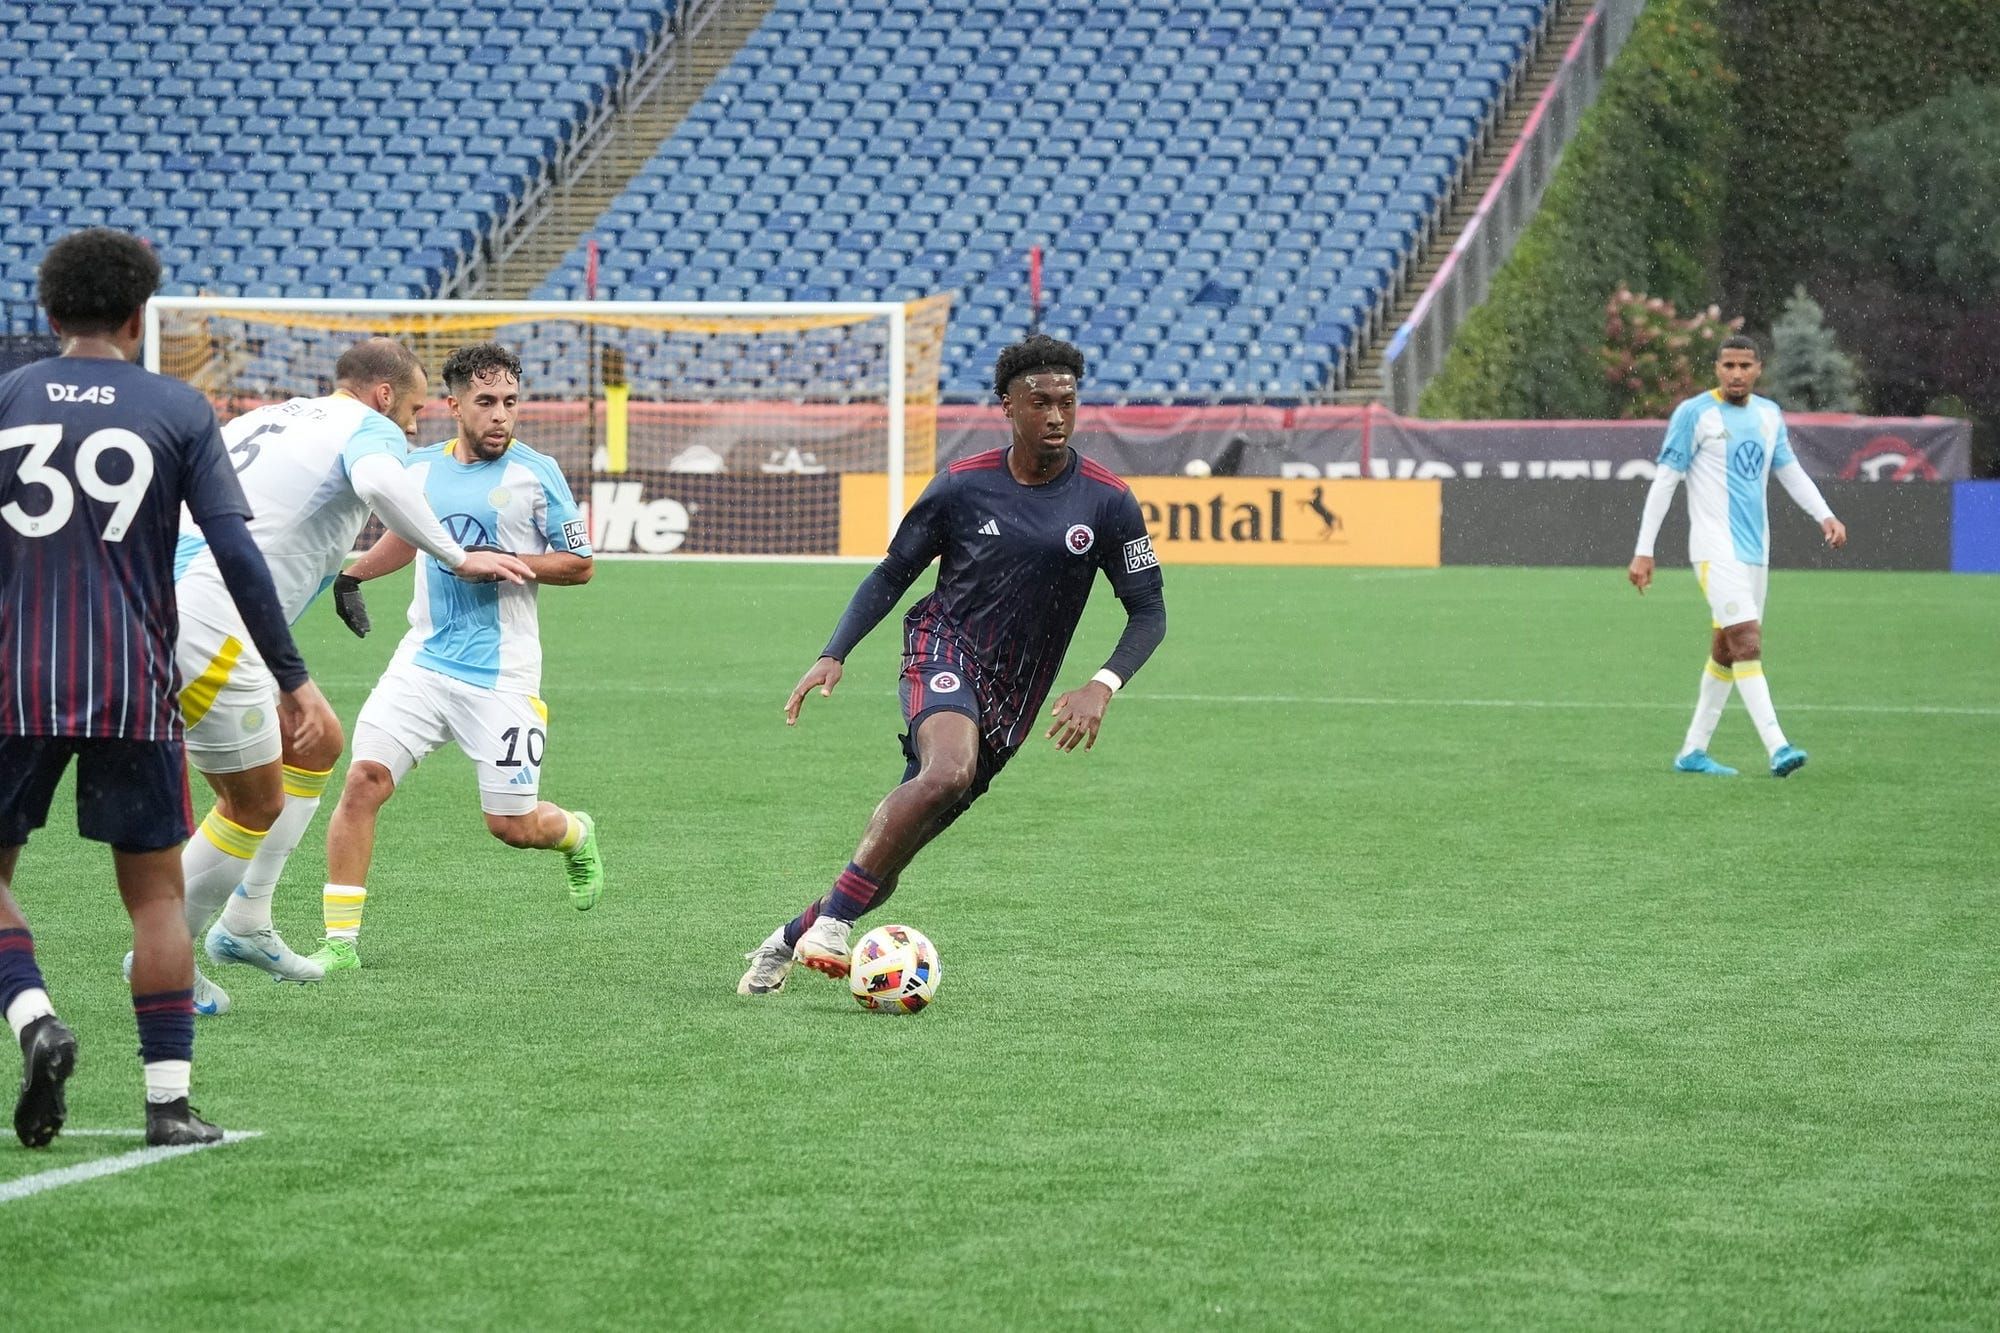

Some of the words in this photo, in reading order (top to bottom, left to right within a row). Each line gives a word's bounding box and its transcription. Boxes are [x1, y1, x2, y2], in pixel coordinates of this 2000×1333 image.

[45, 382, 116, 405] DIAS
[228, 423, 287, 474] 5
[0, 423, 154, 543] 39
[495, 726, 546, 767] 10
